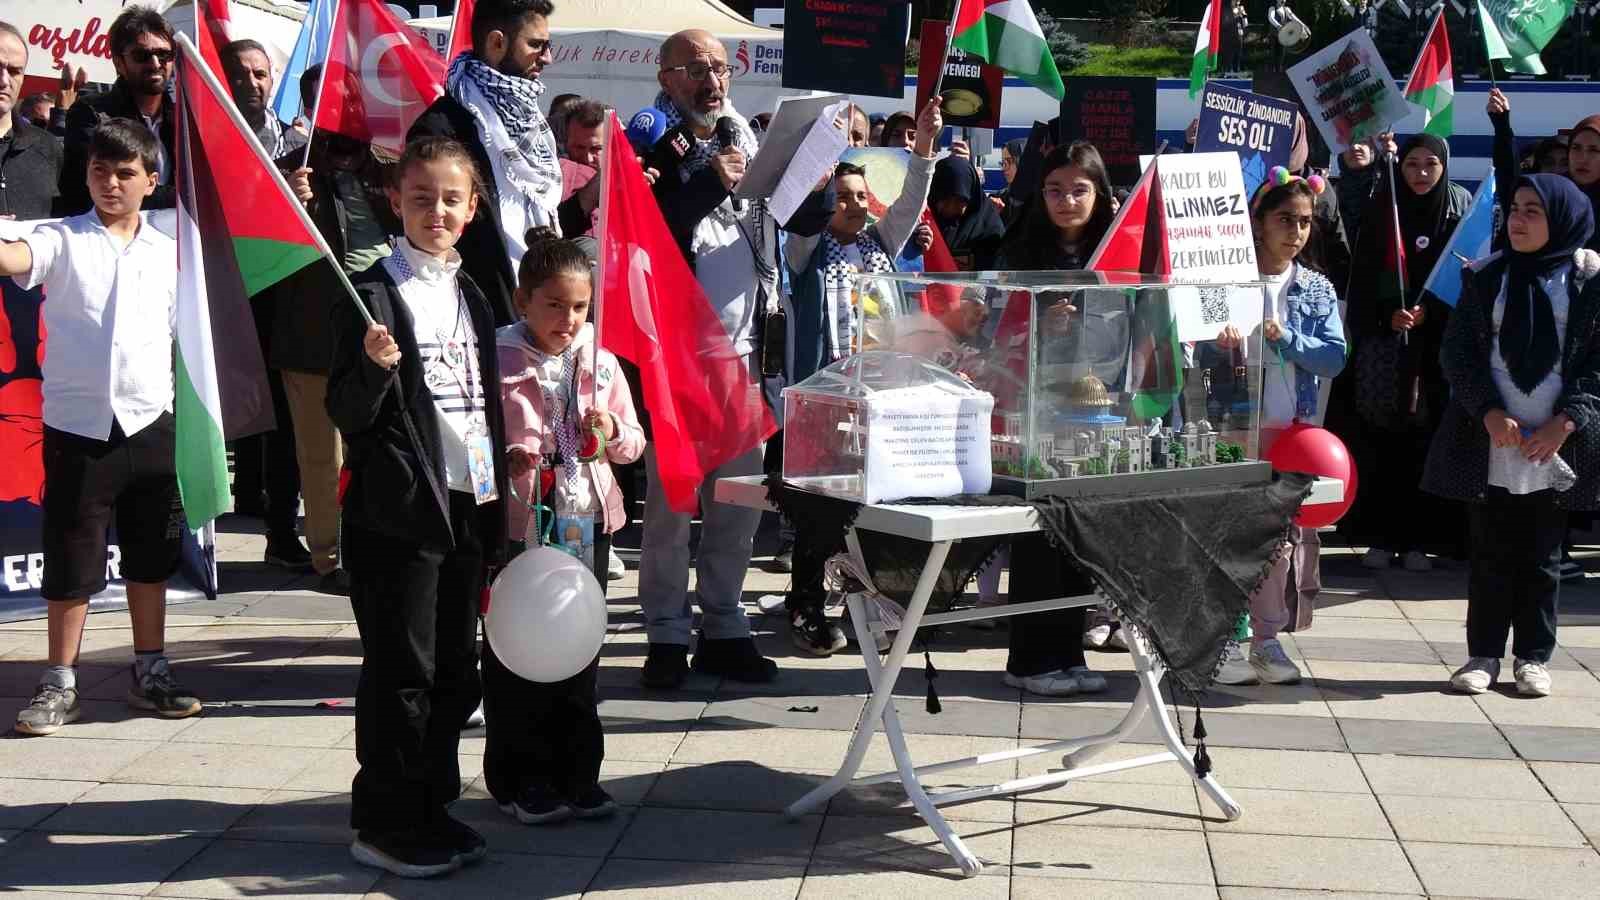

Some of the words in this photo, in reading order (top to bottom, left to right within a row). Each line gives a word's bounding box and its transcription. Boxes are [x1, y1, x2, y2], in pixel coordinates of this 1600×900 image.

[755, 44, 783, 59] Den
[1205, 92, 1246, 116] SESSİZLİK
[1246, 100, 1293, 129] ZİNDANDIR,
[676, 131, 691, 152] TRT
[1218, 115, 1248, 146] SES
[1248, 122, 1274, 153] OL!
[1208, 169, 1227, 189] BU
[1166, 194, 1245, 218] İLİNMEZ
[1171, 244, 1254, 269] ZERİMİZDE
